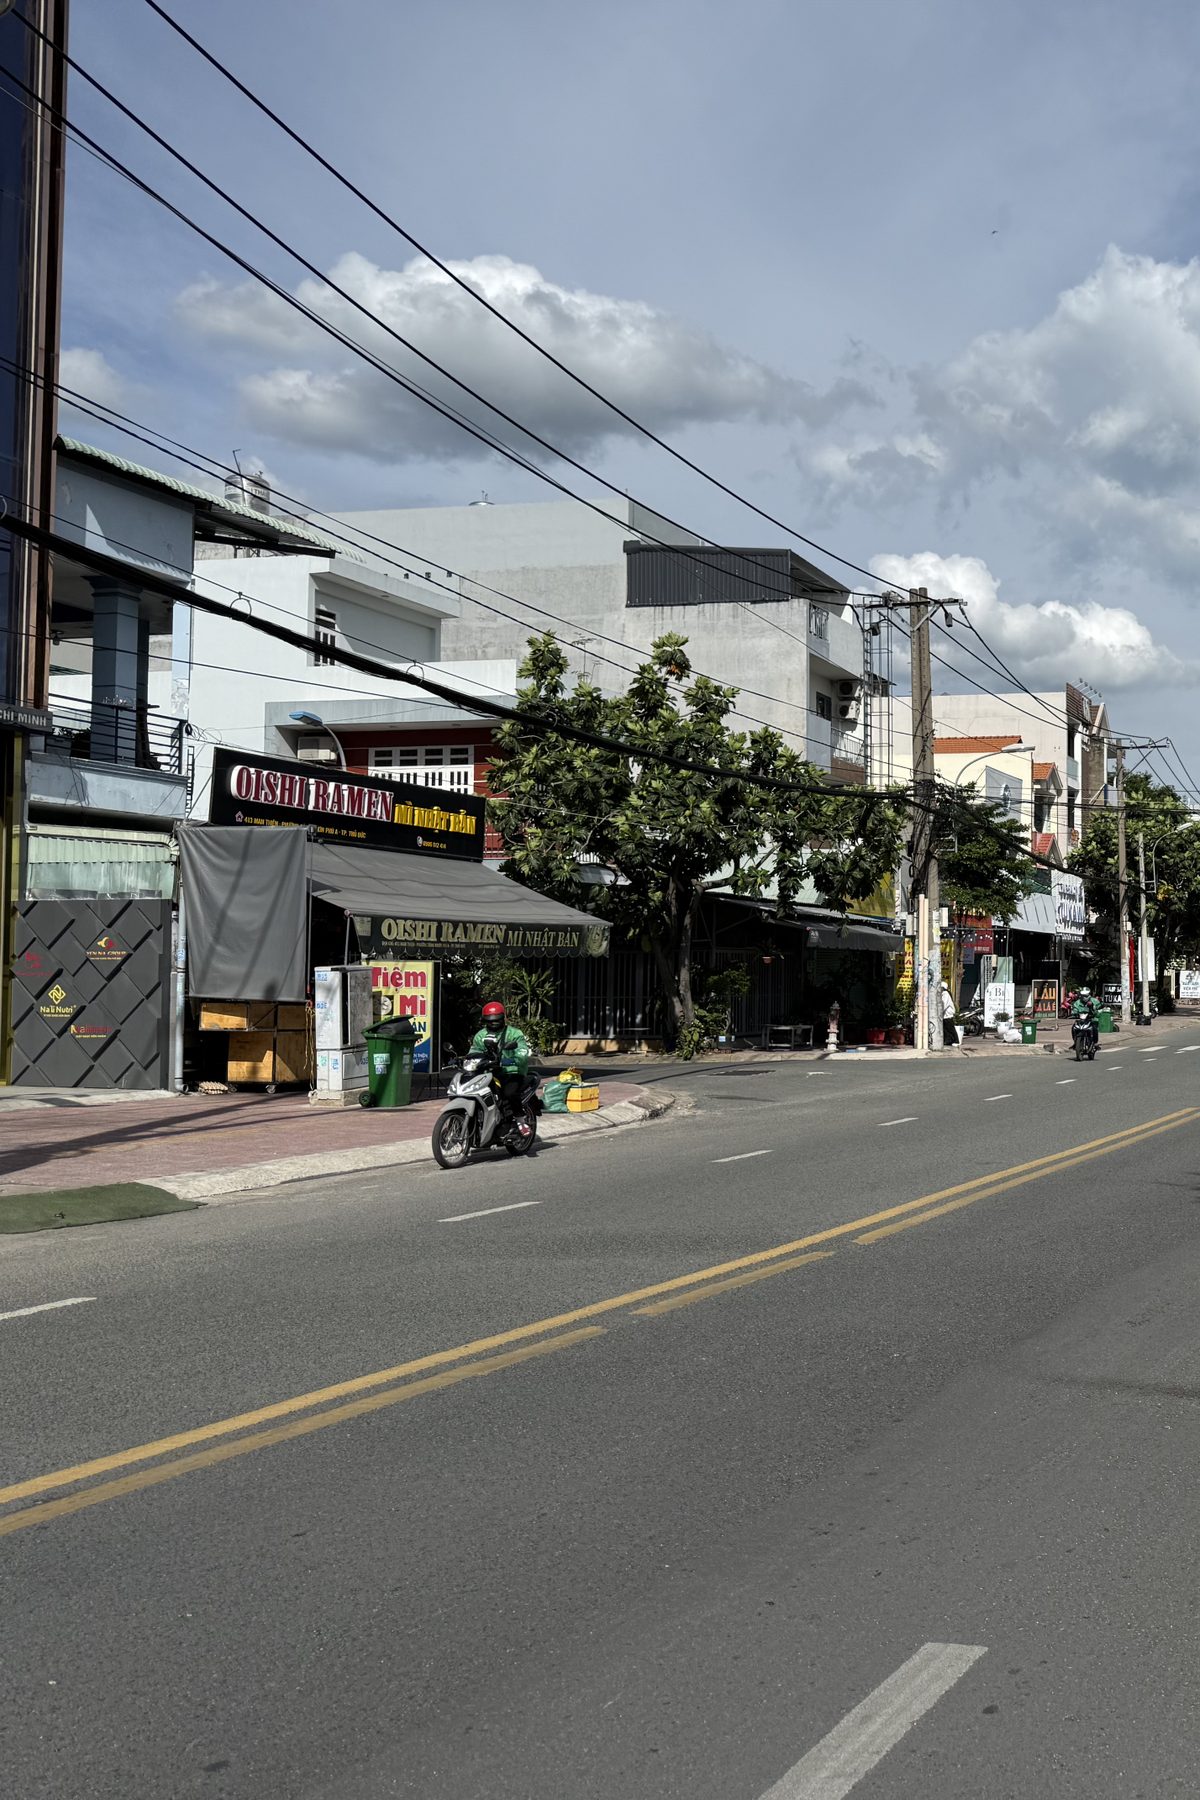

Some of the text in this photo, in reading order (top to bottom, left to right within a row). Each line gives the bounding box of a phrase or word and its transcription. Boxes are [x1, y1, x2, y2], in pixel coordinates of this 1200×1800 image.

[18, 712, 47, 727] MINH
[231, 765, 477, 835] OISHI RAMEN MÌ NHẬT BẢN
[381, 918, 438, 941] OISHI
[441, 921, 506, 943] RAMEN
[507, 927, 523, 947] MÌ
[523, 928, 557, 952] NHẬT
[557, 927, 580, 947] BẢN
